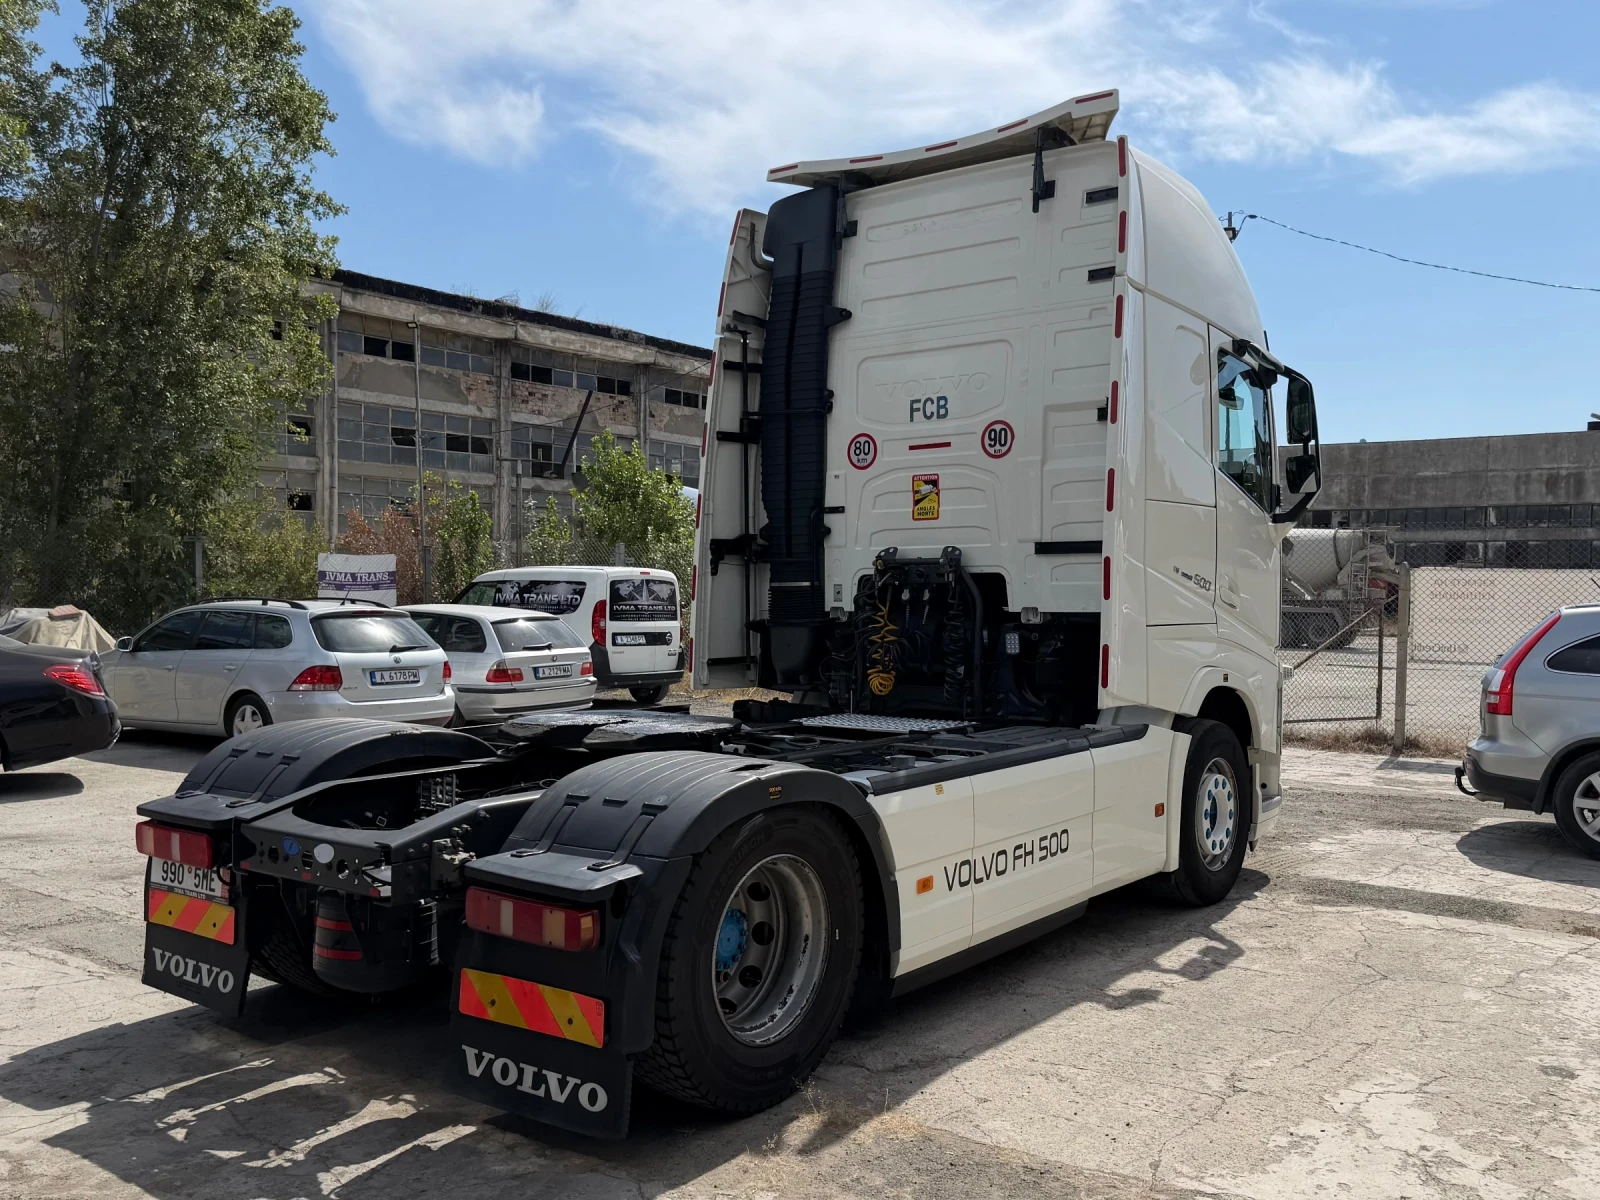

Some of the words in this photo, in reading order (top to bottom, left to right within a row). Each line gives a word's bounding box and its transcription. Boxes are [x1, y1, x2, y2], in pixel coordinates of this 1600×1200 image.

[876, 372, 990, 398] VOLVO
[909, 396, 949, 422] FCB
[853, 440, 871, 456] 80
[987, 427, 1008, 448] 90
[325, 571, 353, 582] IVMA
[355, 572, 389, 582] TRANS
[495, 593, 520, 604] IVMA
[523, 593, 559, 605] TRANS
[561, 594, 581, 605] LTD
[380, 673, 386, 682] A
[943, 849, 1008, 892] VOLVO
[1012, 839, 1034, 871] FH
[1039, 829, 1069, 862] 500
[161, 861, 185, 885] 990
[152, 947, 235, 994] VOLVO
[461, 1044, 609, 1113] VOLVO
